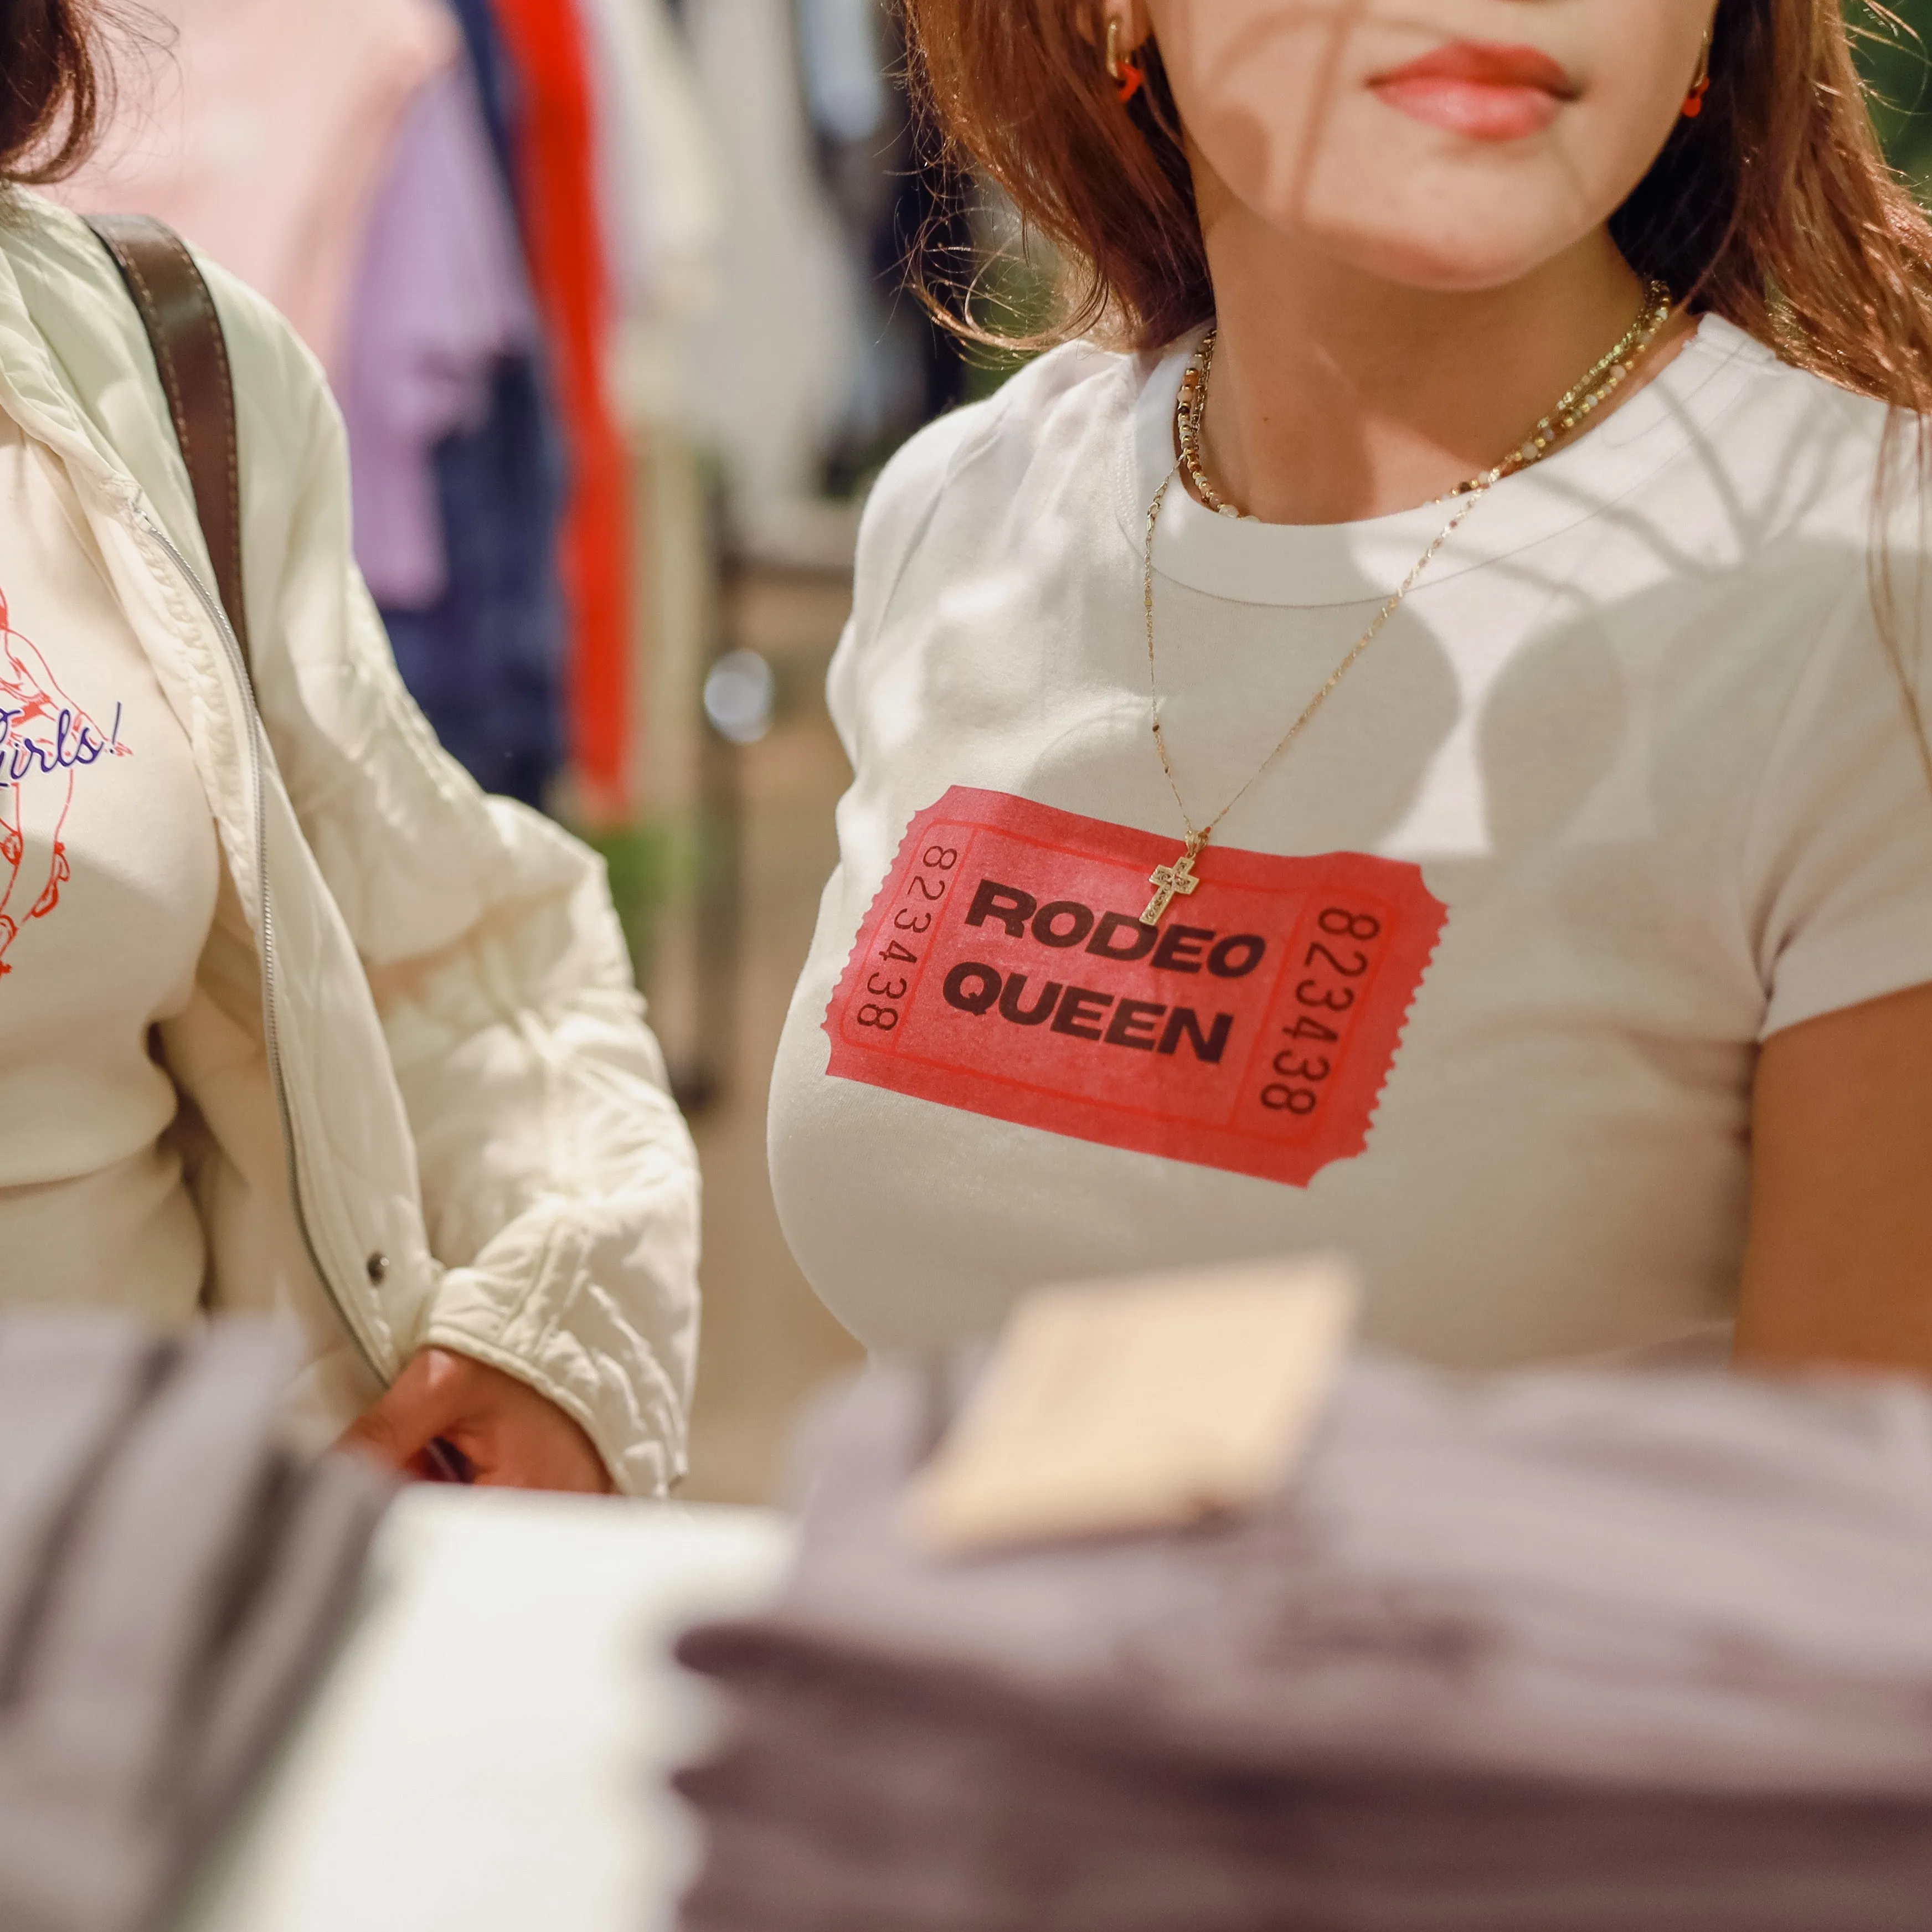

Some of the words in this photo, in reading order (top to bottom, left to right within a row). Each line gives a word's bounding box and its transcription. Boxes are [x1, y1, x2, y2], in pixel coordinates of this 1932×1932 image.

[0, 701, 121, 786] irls!
[857, 845, 958, 1031] 823438
[964, 878, 1266, 978] RODEO
[942, 961, 1234, 1064] QUEEN
[1260, 907, 1380, 1115] 823438
